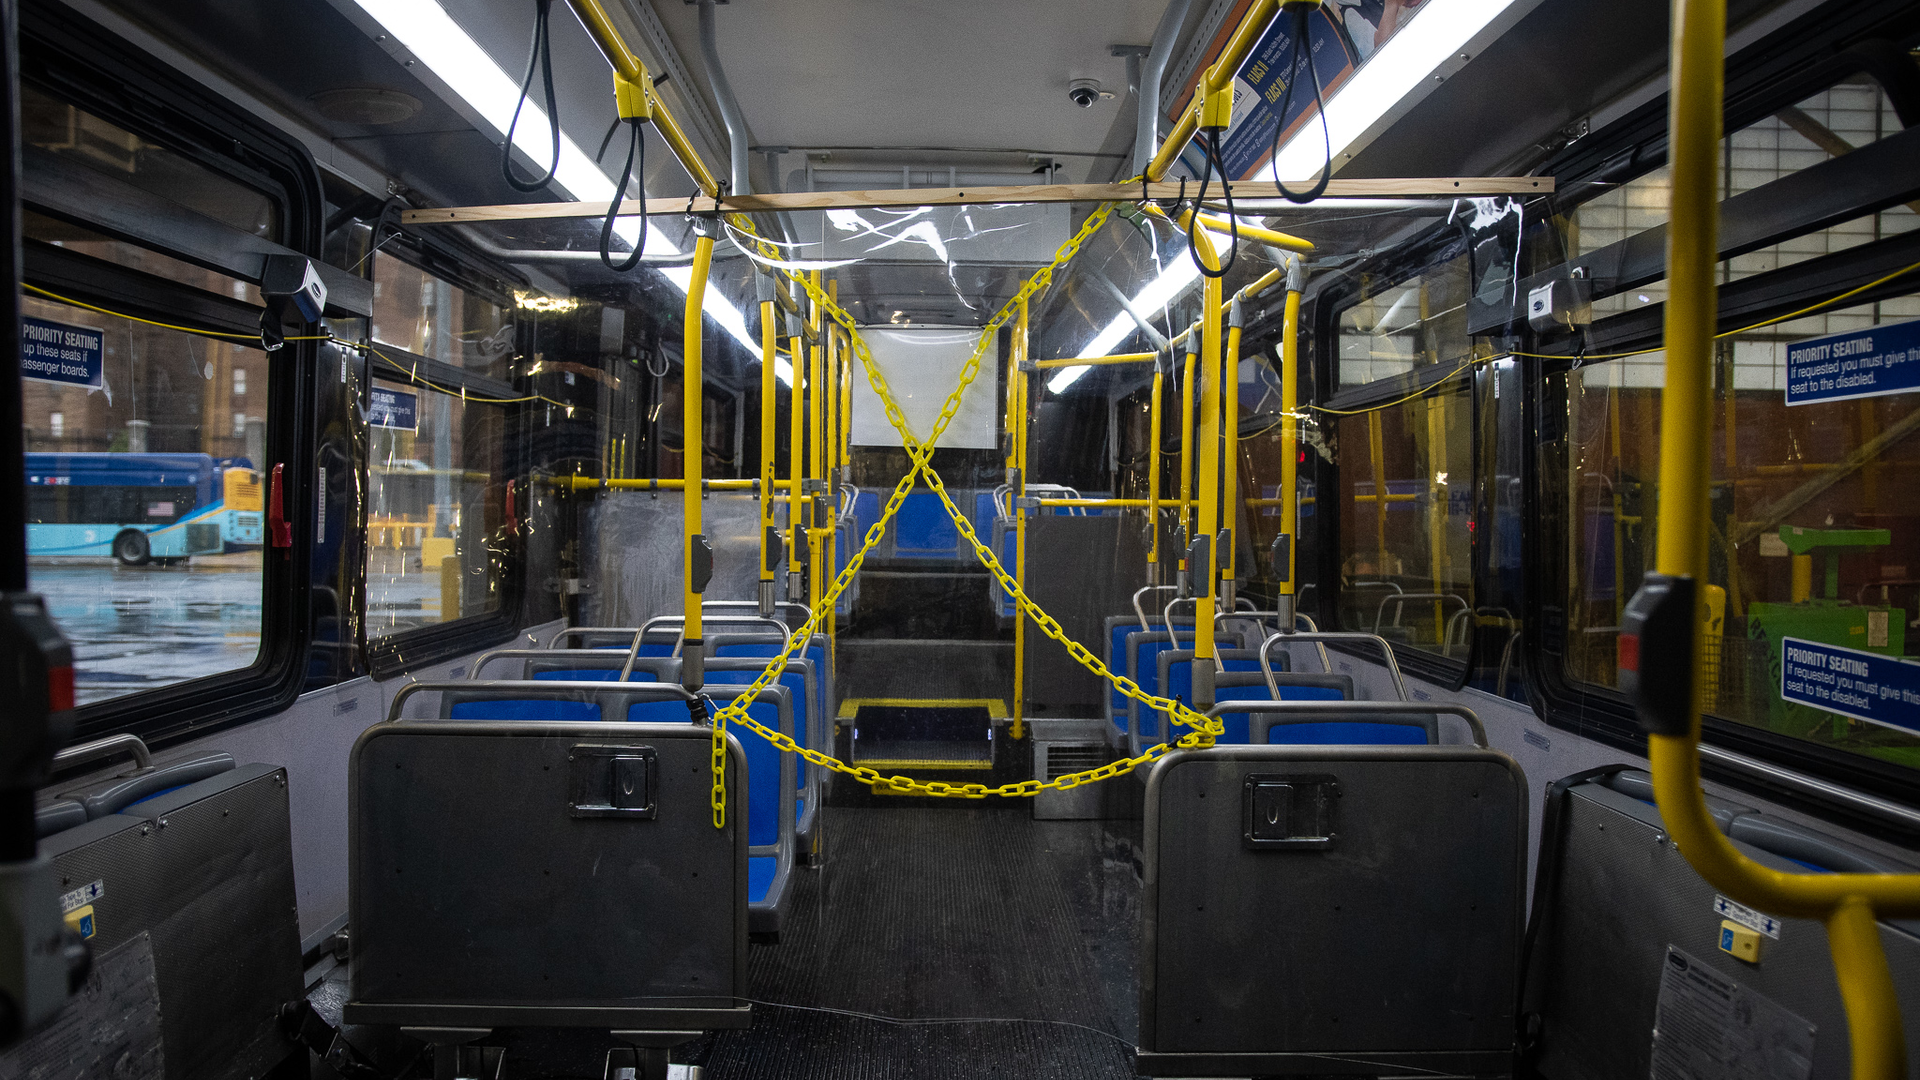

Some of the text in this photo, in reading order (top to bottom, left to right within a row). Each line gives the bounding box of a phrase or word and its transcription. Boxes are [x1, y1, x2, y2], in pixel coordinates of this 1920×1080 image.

[23, 324, 98, 350] PRIORITY SEATING
[1791, 337, 1873, 364] PRIORITY SEATING
[24, 344, 88, 362] up these seats if
[1791, 346, 1920, 379] If requested you must give thi
[61, 364, 90, 377] boards.
[1790, 371, 1876, 394] seat to the disabled.
[1787, 647, 1868, 677] PRIORITY SEATING
[1787, 663, 1920, 705] If requested you must give this
[1787, 680, 1871, 710] seat to the disabled.
